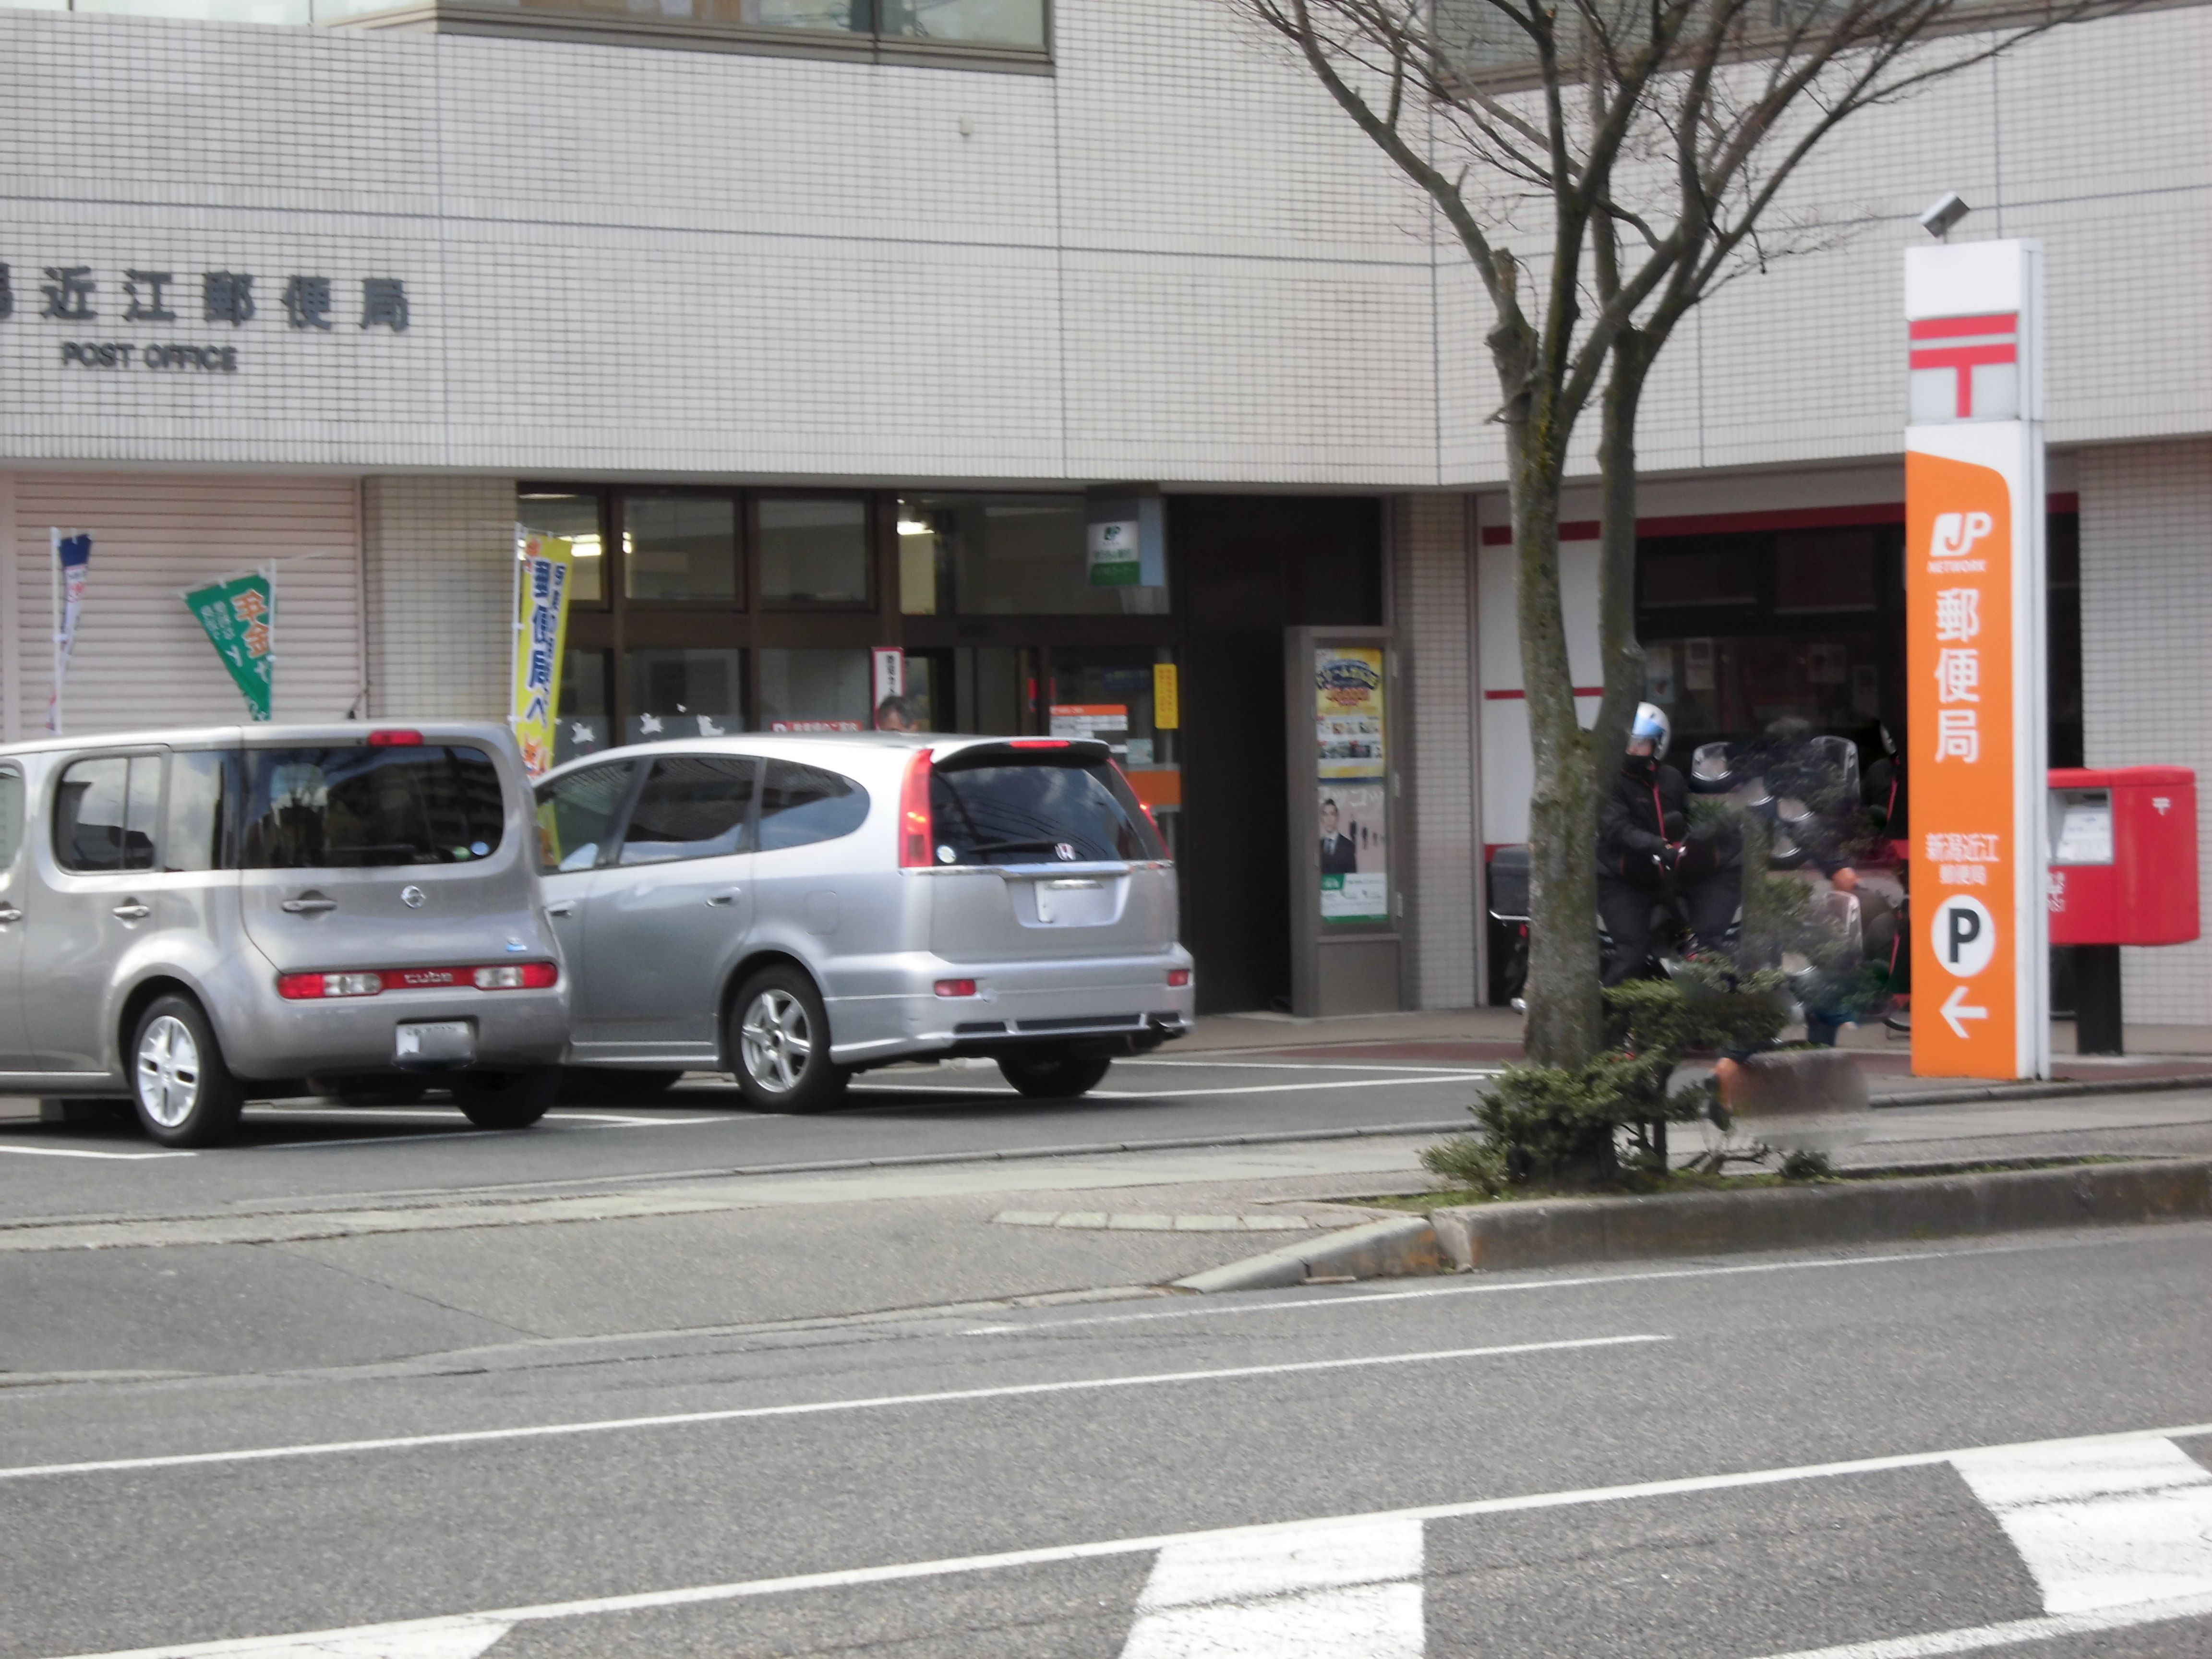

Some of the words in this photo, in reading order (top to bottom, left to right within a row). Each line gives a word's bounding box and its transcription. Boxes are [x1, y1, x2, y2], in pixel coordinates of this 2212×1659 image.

[0, 263, 410, 331] 近江郵便局
[63, 341, 135, 368] POST
[145, 344, 237, 371] OFFICE
[1927, 561, 1986, 573] NETWORK
[1935, 588, 1980, 764] 郵便局
[1948, 908, 1980, 963] P
[404, 971, 454, 984] cube
